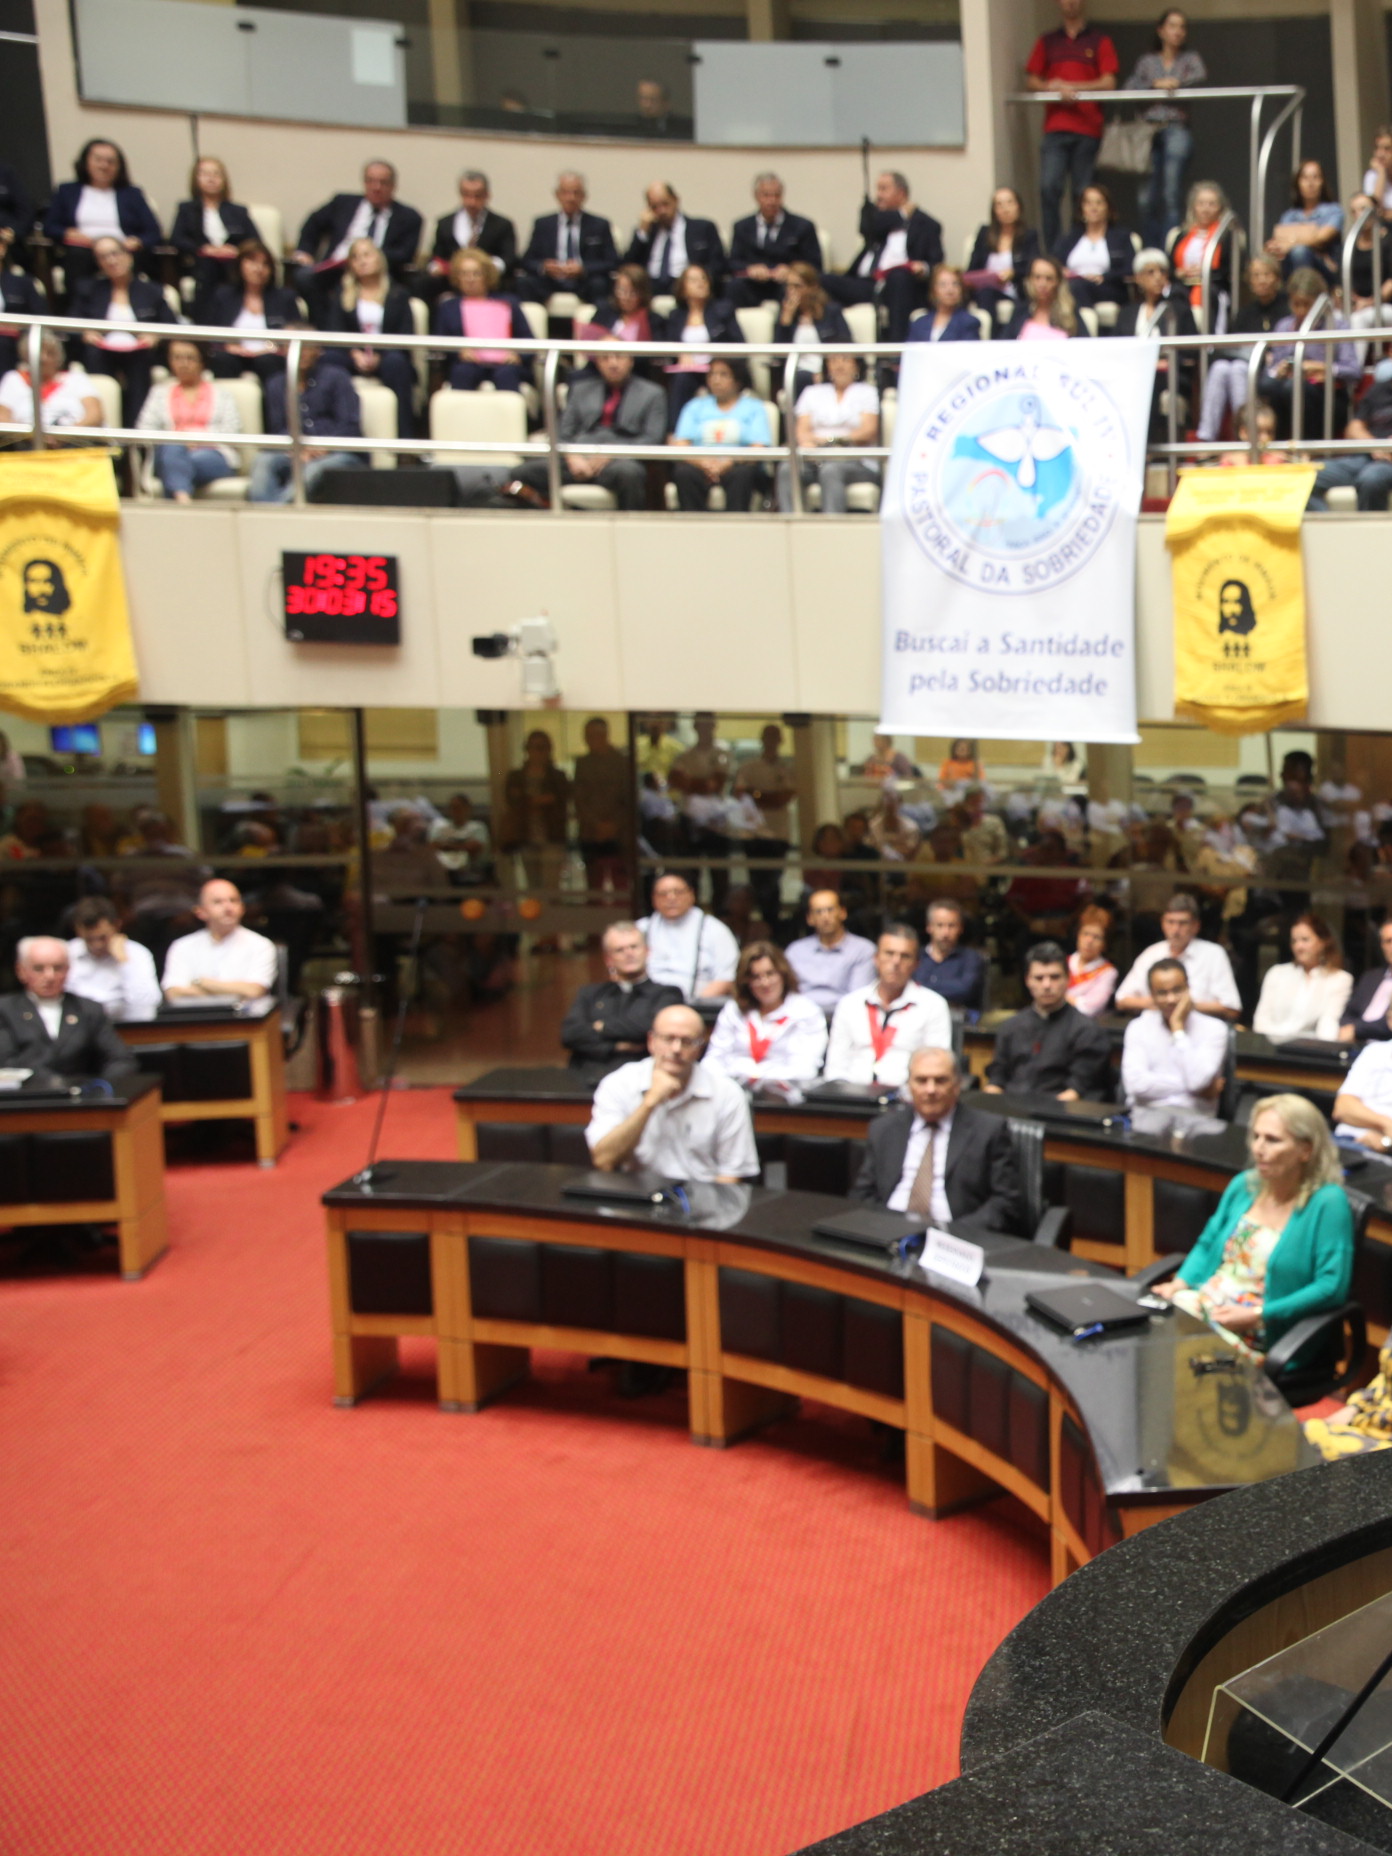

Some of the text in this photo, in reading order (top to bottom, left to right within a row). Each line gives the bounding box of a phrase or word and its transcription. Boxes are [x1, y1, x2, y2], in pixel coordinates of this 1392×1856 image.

[926, 365, 1039, 442] REGIONAL
[910, 471, 971, 576] PASTORAL
[980, 561, 1010, 585] DA
[303, 553, 389, 591] 19:35
[894, 629, 1125, 658] Buscai a Santidade
[908, 668, 1109, 697] pela Sobriedade
